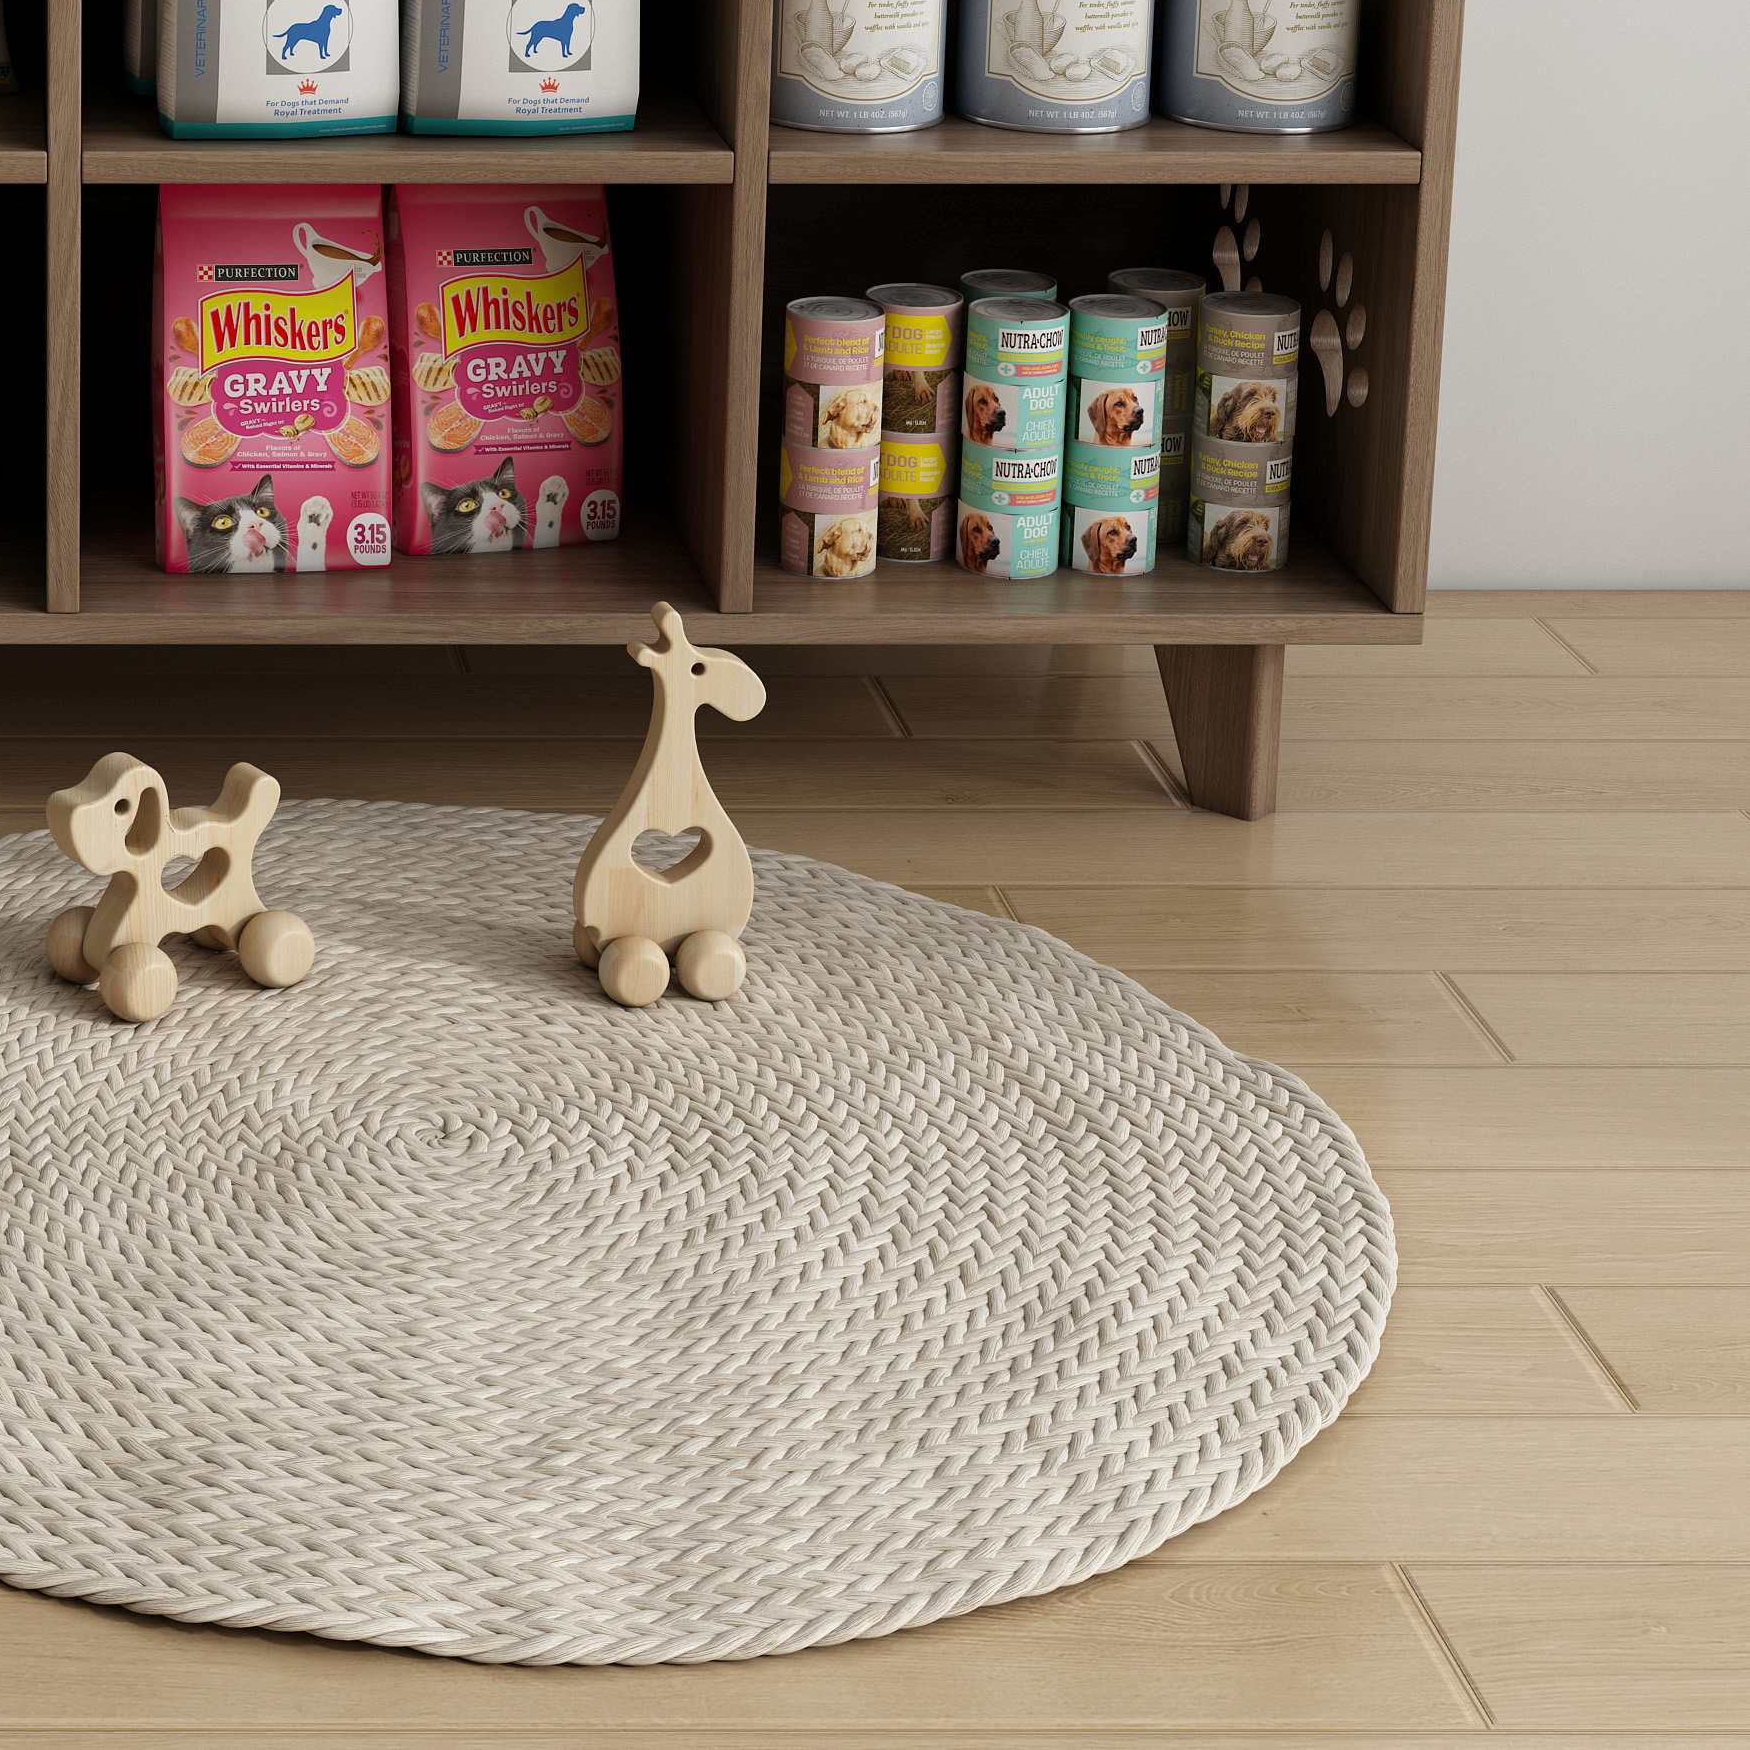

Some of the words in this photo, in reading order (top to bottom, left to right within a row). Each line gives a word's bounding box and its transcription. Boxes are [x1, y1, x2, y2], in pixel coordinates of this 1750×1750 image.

[281, 100, 299, 109] Dogs
[522, 97, 541, 106] Dogs
[274, 108, 298, 117] Royal
[300, 107, 341, 116] Treatment
[515, 107, 539, 115] Royal
[541, 106, 582, 114] Treatment
[456, 250, 530, 263] PURFECTION
[217, 267, 296, 278] PURFECTION
[452, 286, 579, 338] Whiskers
[211, 301, 346, 353] Whiskers
[467, 350, 567, 383] GRAVY
[224, 368, 331, 397] GRAVY
[482, 380, 557, 399] Swirlers
[1022, 385, 1059, 399] ADULT
[239, 397, 320, 414] Swirlers
[1030, 398, 1054, 410] DOG
[587, 500, 617, 520] 3.15
[587, 520, 616, 530] POUNDS
[1017, 514, 1054, 528] ADULT
[354, 523, 386, 544] 3.15
[1024, 527, 1048, 539] DOG
[354, 545, 386, 554] POUNDS
